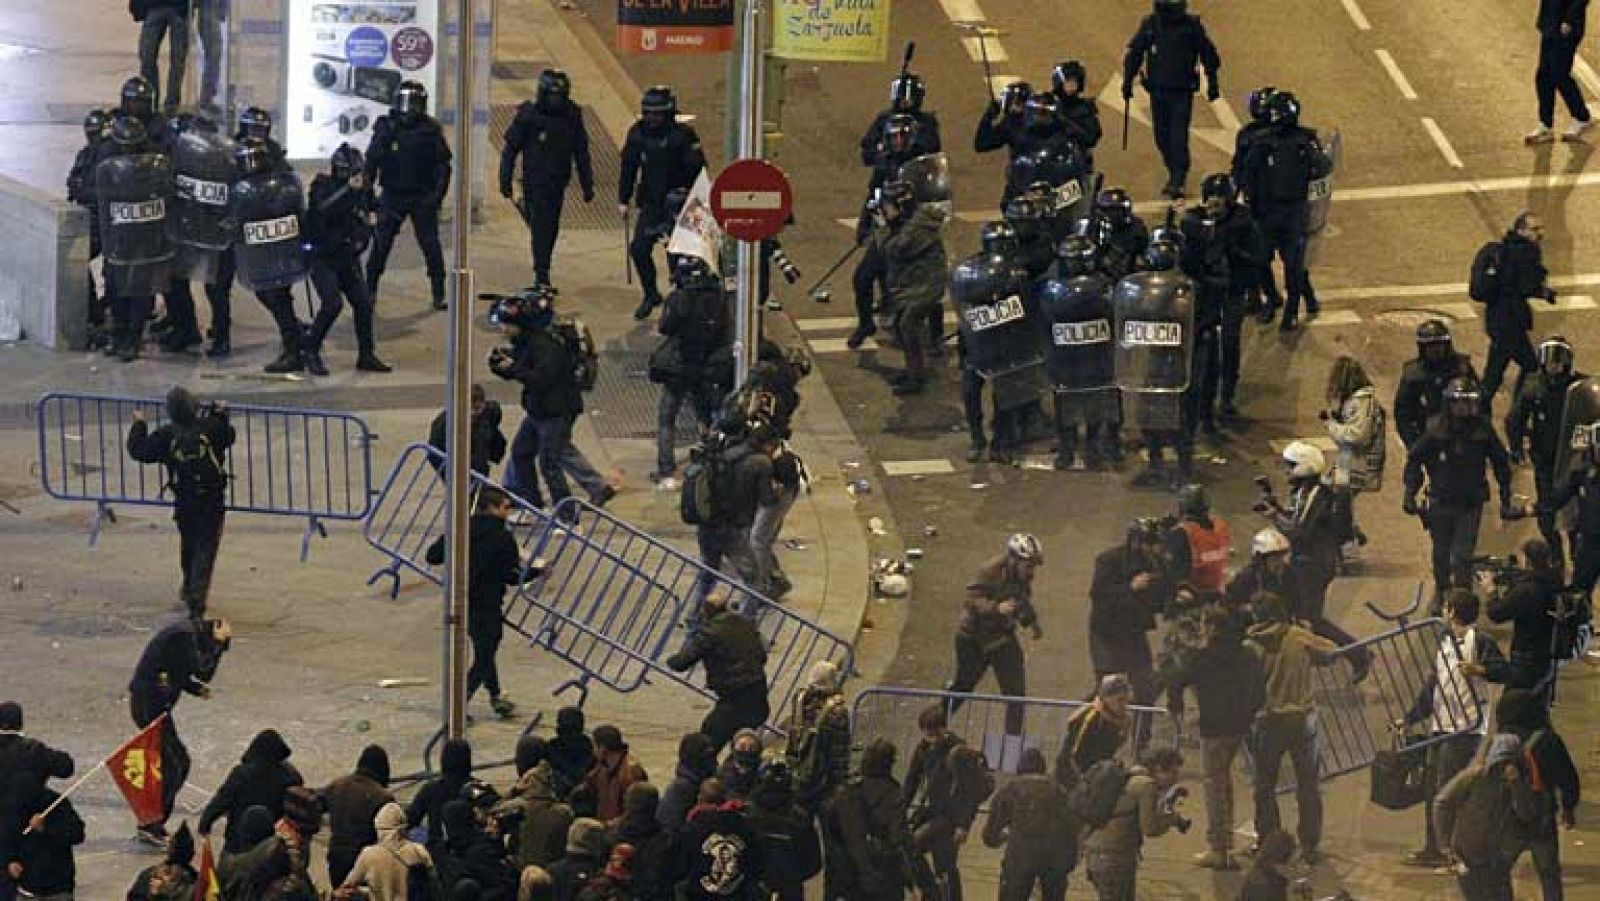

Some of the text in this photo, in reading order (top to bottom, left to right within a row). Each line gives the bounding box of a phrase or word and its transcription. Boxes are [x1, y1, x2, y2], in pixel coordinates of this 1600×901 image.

[111, 200, 164, 222] POLICIA
[245, 217, 297, 242] POLICIA
[968, 297, 1023, 331] POLICIA
[1054, 321, 1109, 343] POLICIA
[1125, 322, 1180, 343] POLICIA
